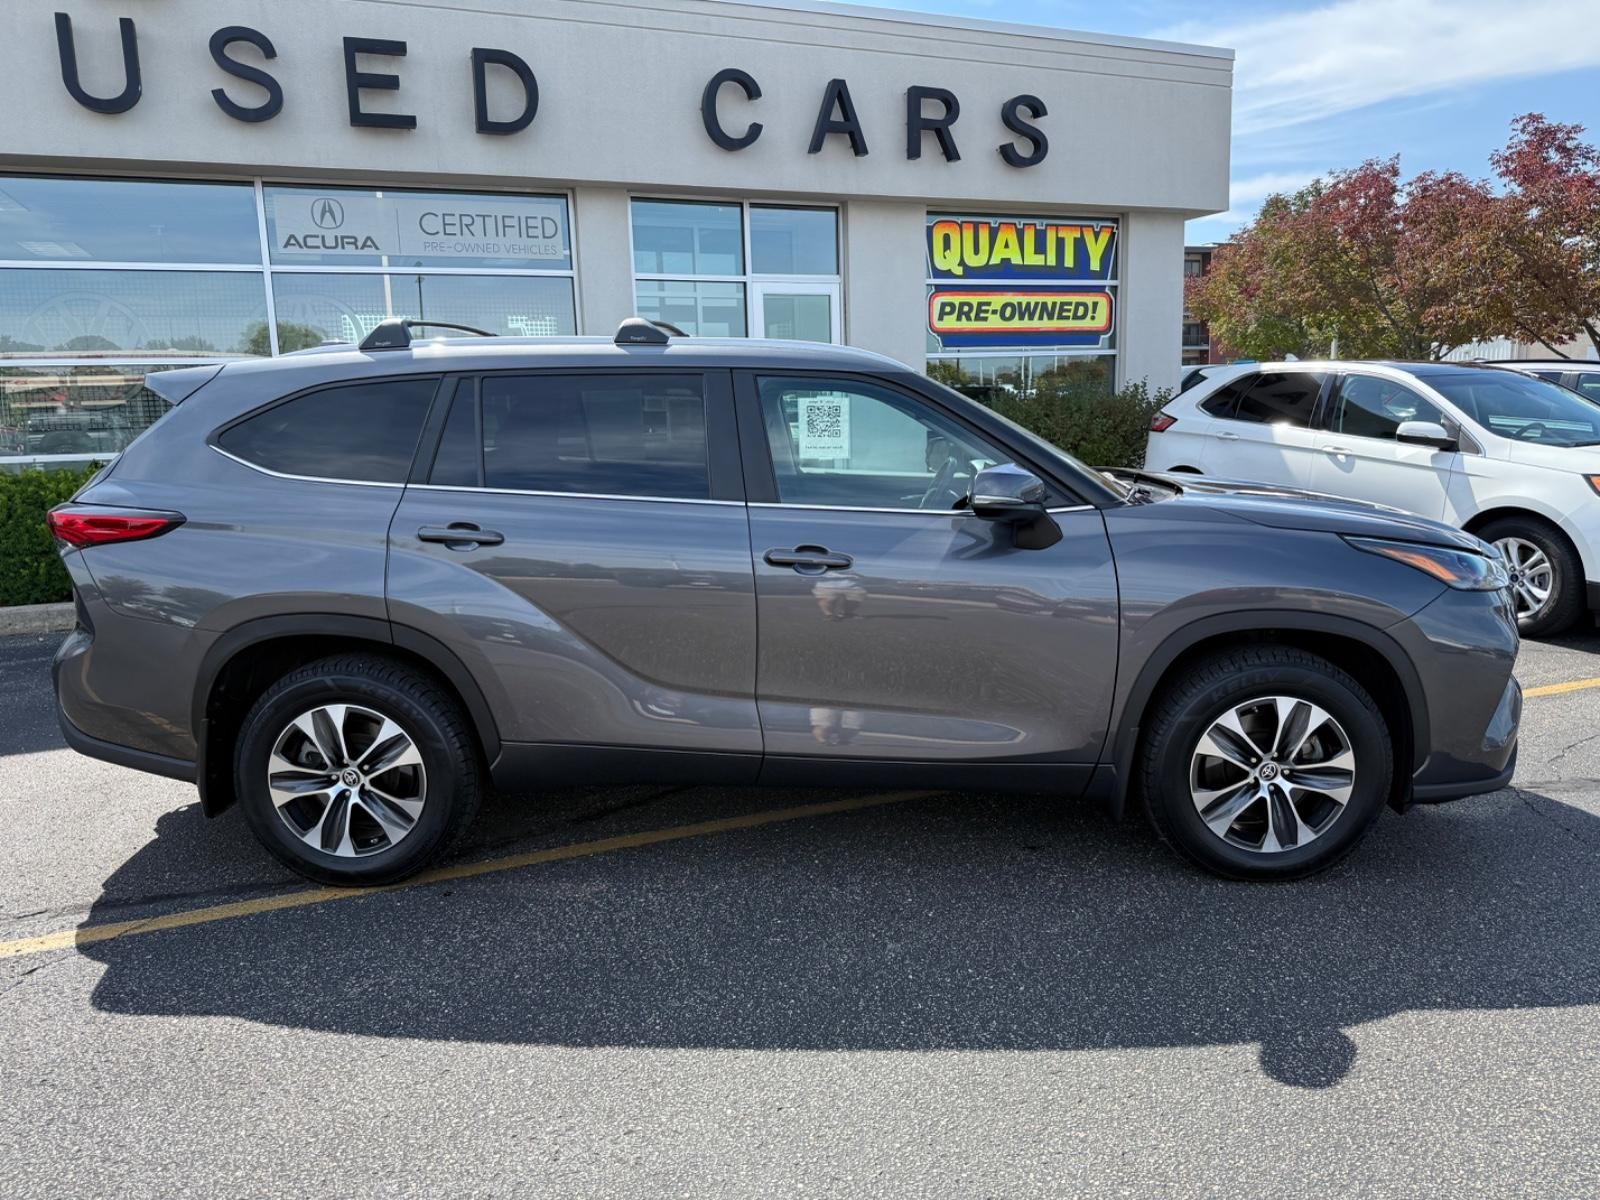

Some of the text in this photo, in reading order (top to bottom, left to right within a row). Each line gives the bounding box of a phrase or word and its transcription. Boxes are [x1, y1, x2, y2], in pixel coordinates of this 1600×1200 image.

[55, 12, 1049, 168] USED CARS
[418, 211, 558, 240] CERTIFIED
[282, 234, 381, 251] ACURA
[423, 241, 559, 256] PRE-OWNED VEHICLES
[932, 221, 1112, 275] QUALITY
[937, 301, 1098, 322] PRE-OWNED!
